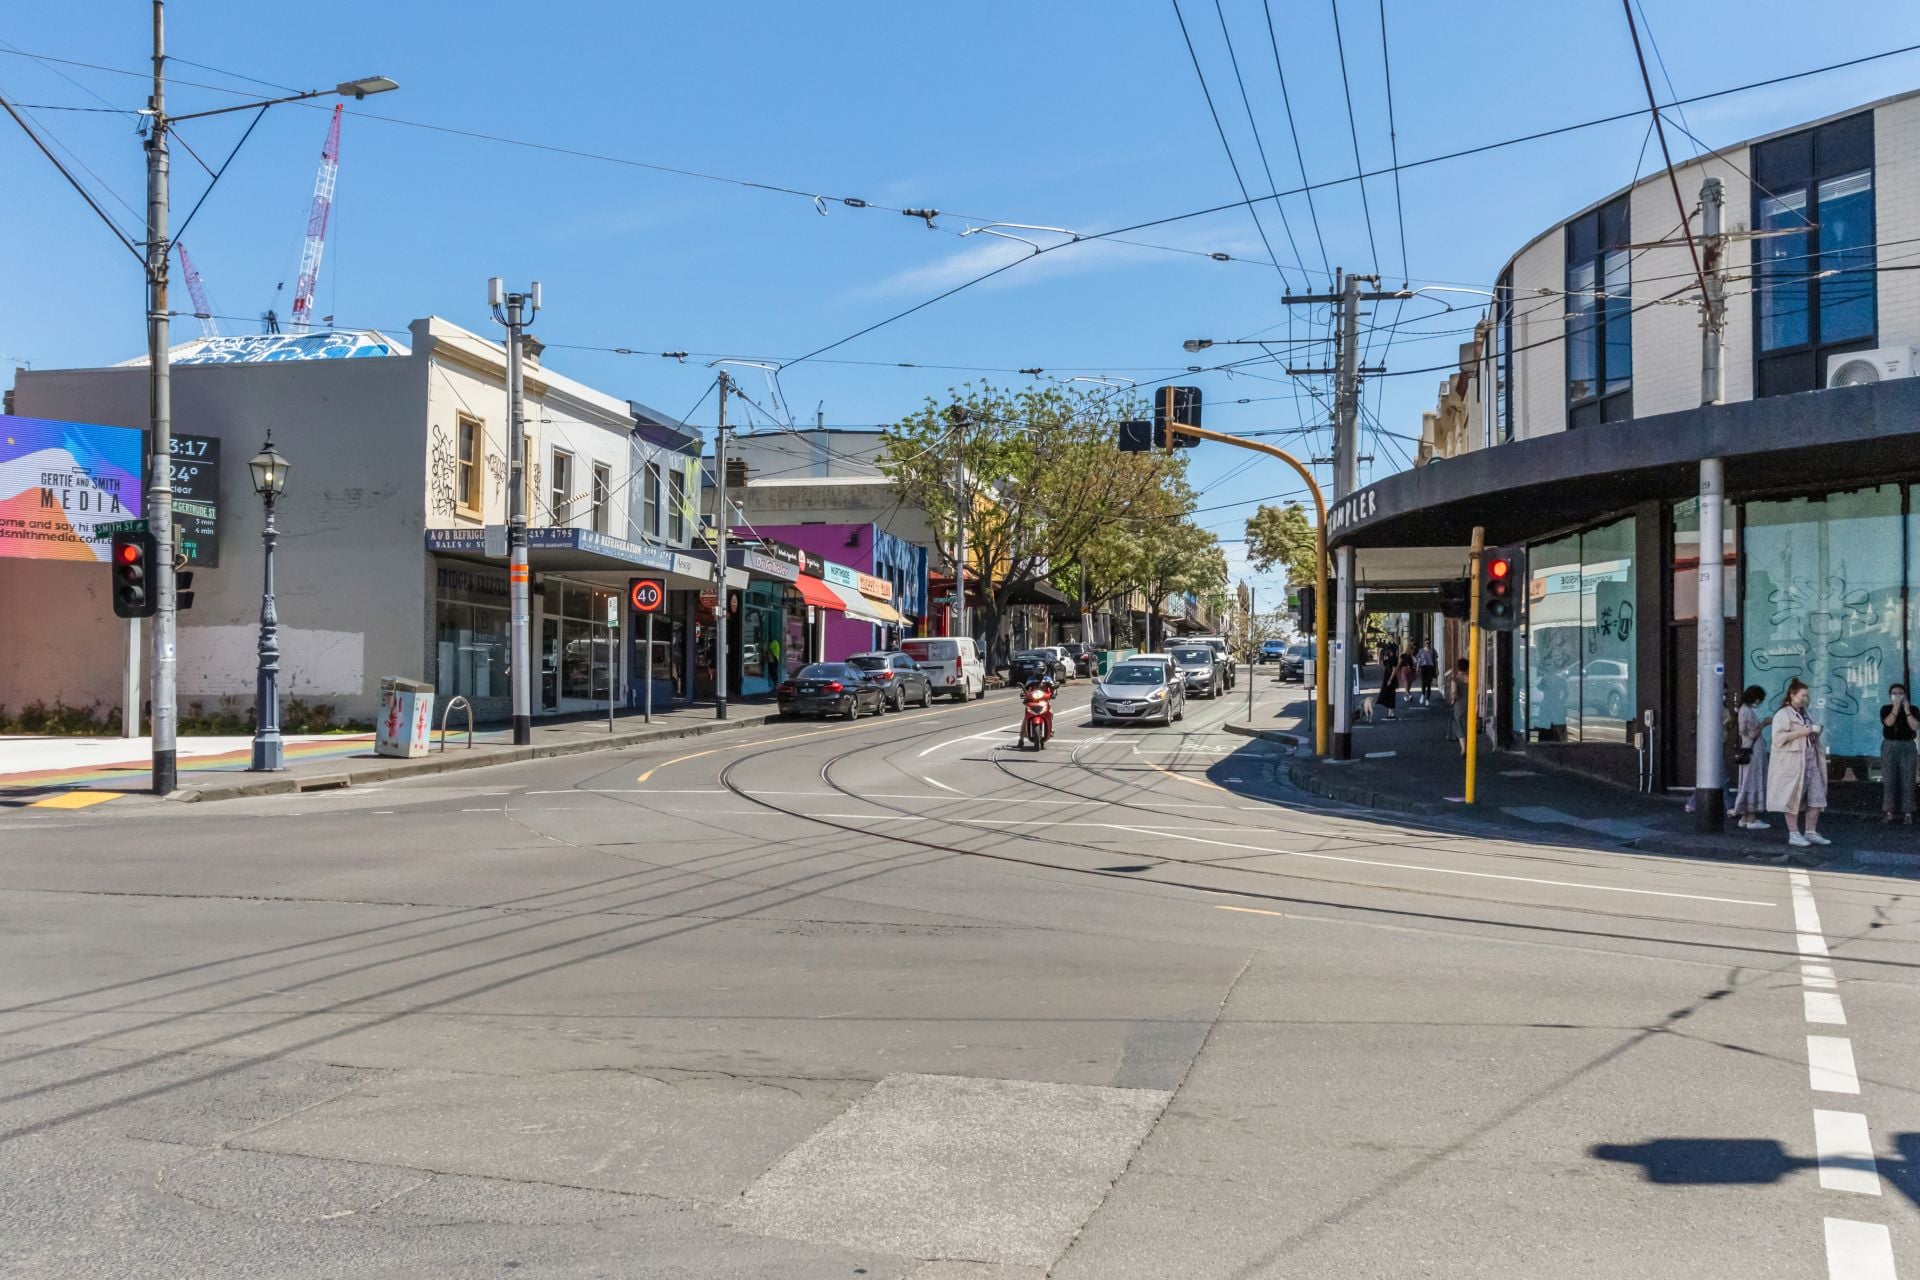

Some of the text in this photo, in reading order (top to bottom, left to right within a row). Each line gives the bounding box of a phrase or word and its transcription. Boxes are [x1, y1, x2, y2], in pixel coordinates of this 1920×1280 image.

[41, 472, 120, 491] GERTIE AND SMITH
[40, 487, 120, 513] MEDIA
[178, 502, 216, 517] GERTRUDE ST
[0, 518, 25, 527] ome
[29, 520, 52, 530] and
[55, 522, 75, 533] say
[79, 522, 89, 532] hi
[97, 520, 134, 534] SMITH ST
[201, 519, 214, 527] min
[201, 527, 214, 535] min
[430, 530, 437, 541] A
[445, 530, 450, 541] B
[453, 530, 485, 541] REFRIGE
[435, 541, 462, 549] SALES
[830, 565, 850, 580] NORTHSIDE
[637, 589, 657, 602] 40
